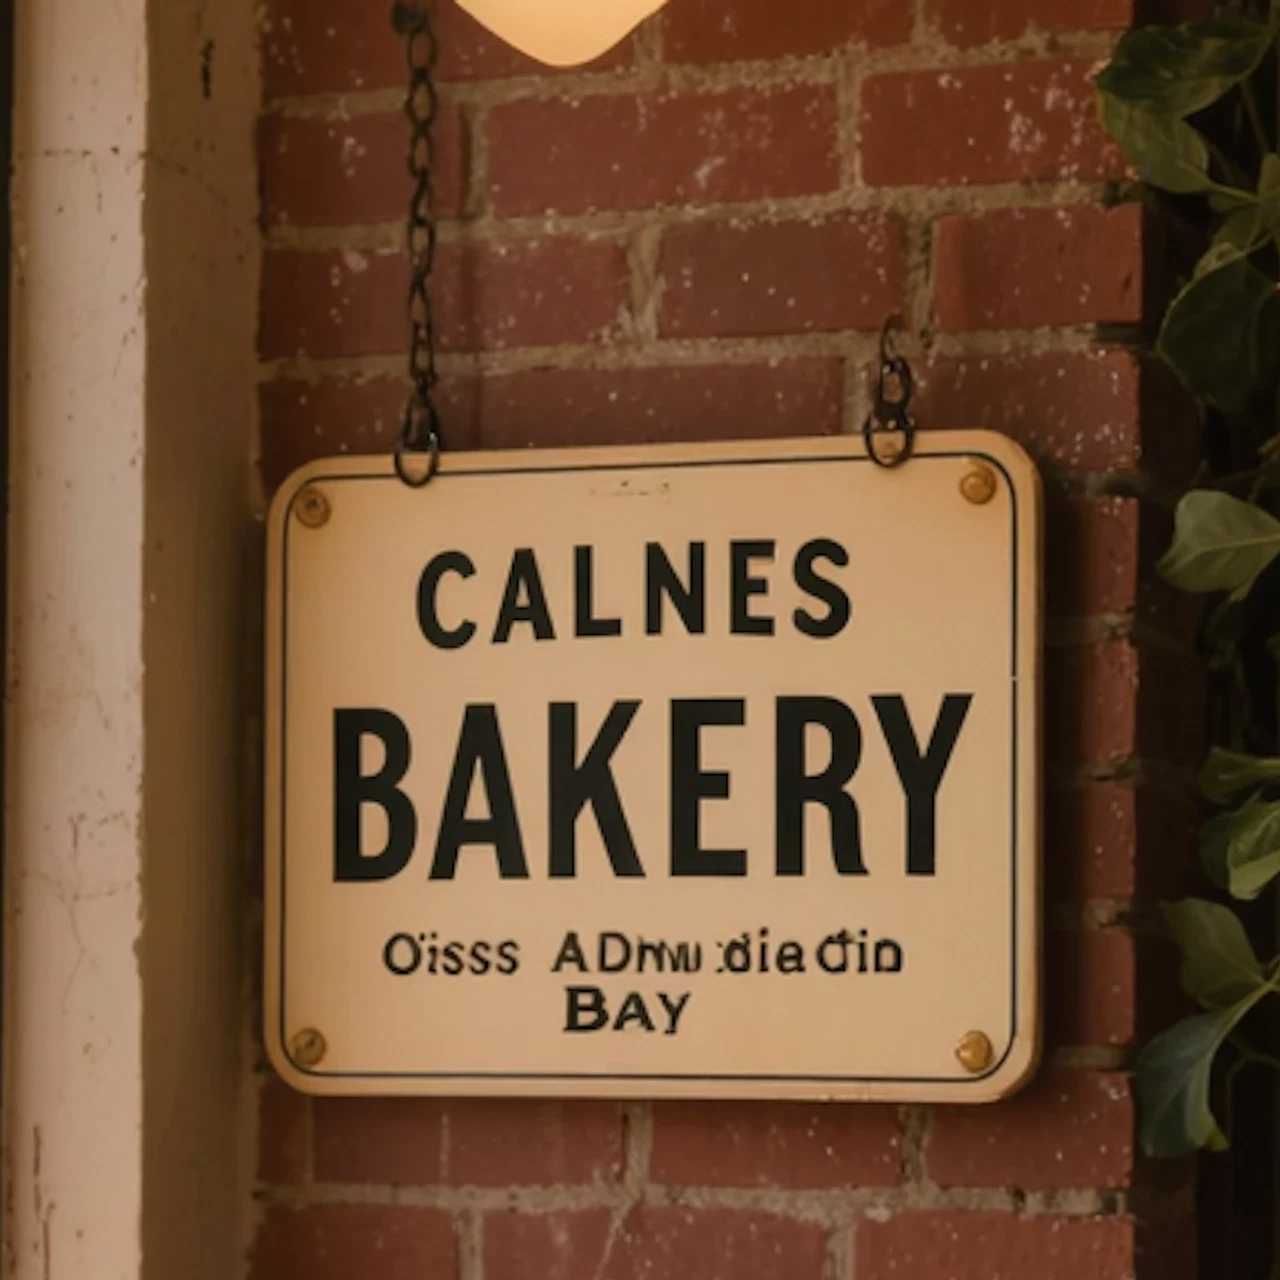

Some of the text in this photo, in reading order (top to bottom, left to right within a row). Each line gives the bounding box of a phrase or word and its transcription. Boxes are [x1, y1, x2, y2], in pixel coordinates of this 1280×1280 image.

[415, 537, 852, 651] CALNES
[331, 692, 974, 884] BAKERY
[562, 985, 692, 1036] BAY
